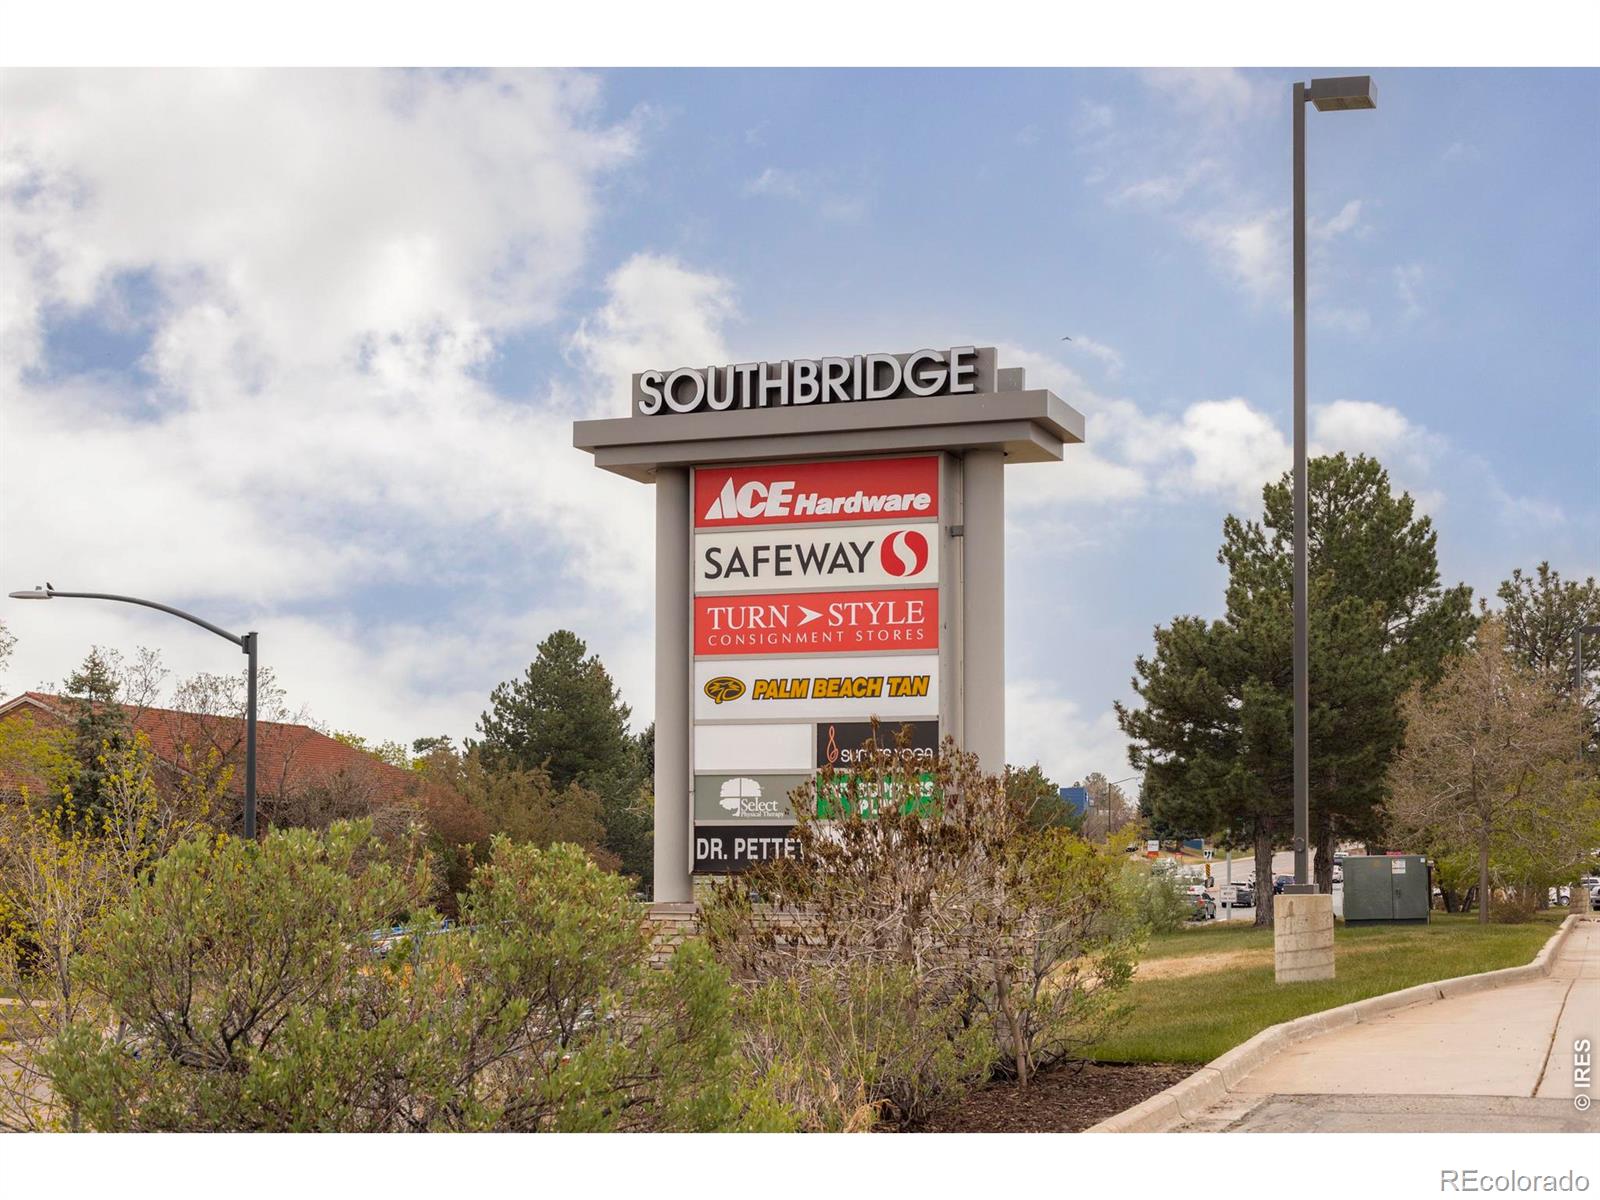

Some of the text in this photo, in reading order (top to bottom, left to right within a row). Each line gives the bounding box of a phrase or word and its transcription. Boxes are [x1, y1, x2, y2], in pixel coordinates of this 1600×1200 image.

[638, 346, 977, 416] SOUTHBRIDGE
[704, 476, 931, 520] ACE Hardware
[704, 541, 875, 579] SAFEWAY
[707, 600, 925, 630] TURN STYLE
[708, 628, 924, 647] CONSIGNMENT STORES
[752, 675, 930, 701] PALM BEACH TAN
[741, 797, 779, 812] Select
[696, 838, 728, 860] DR.
